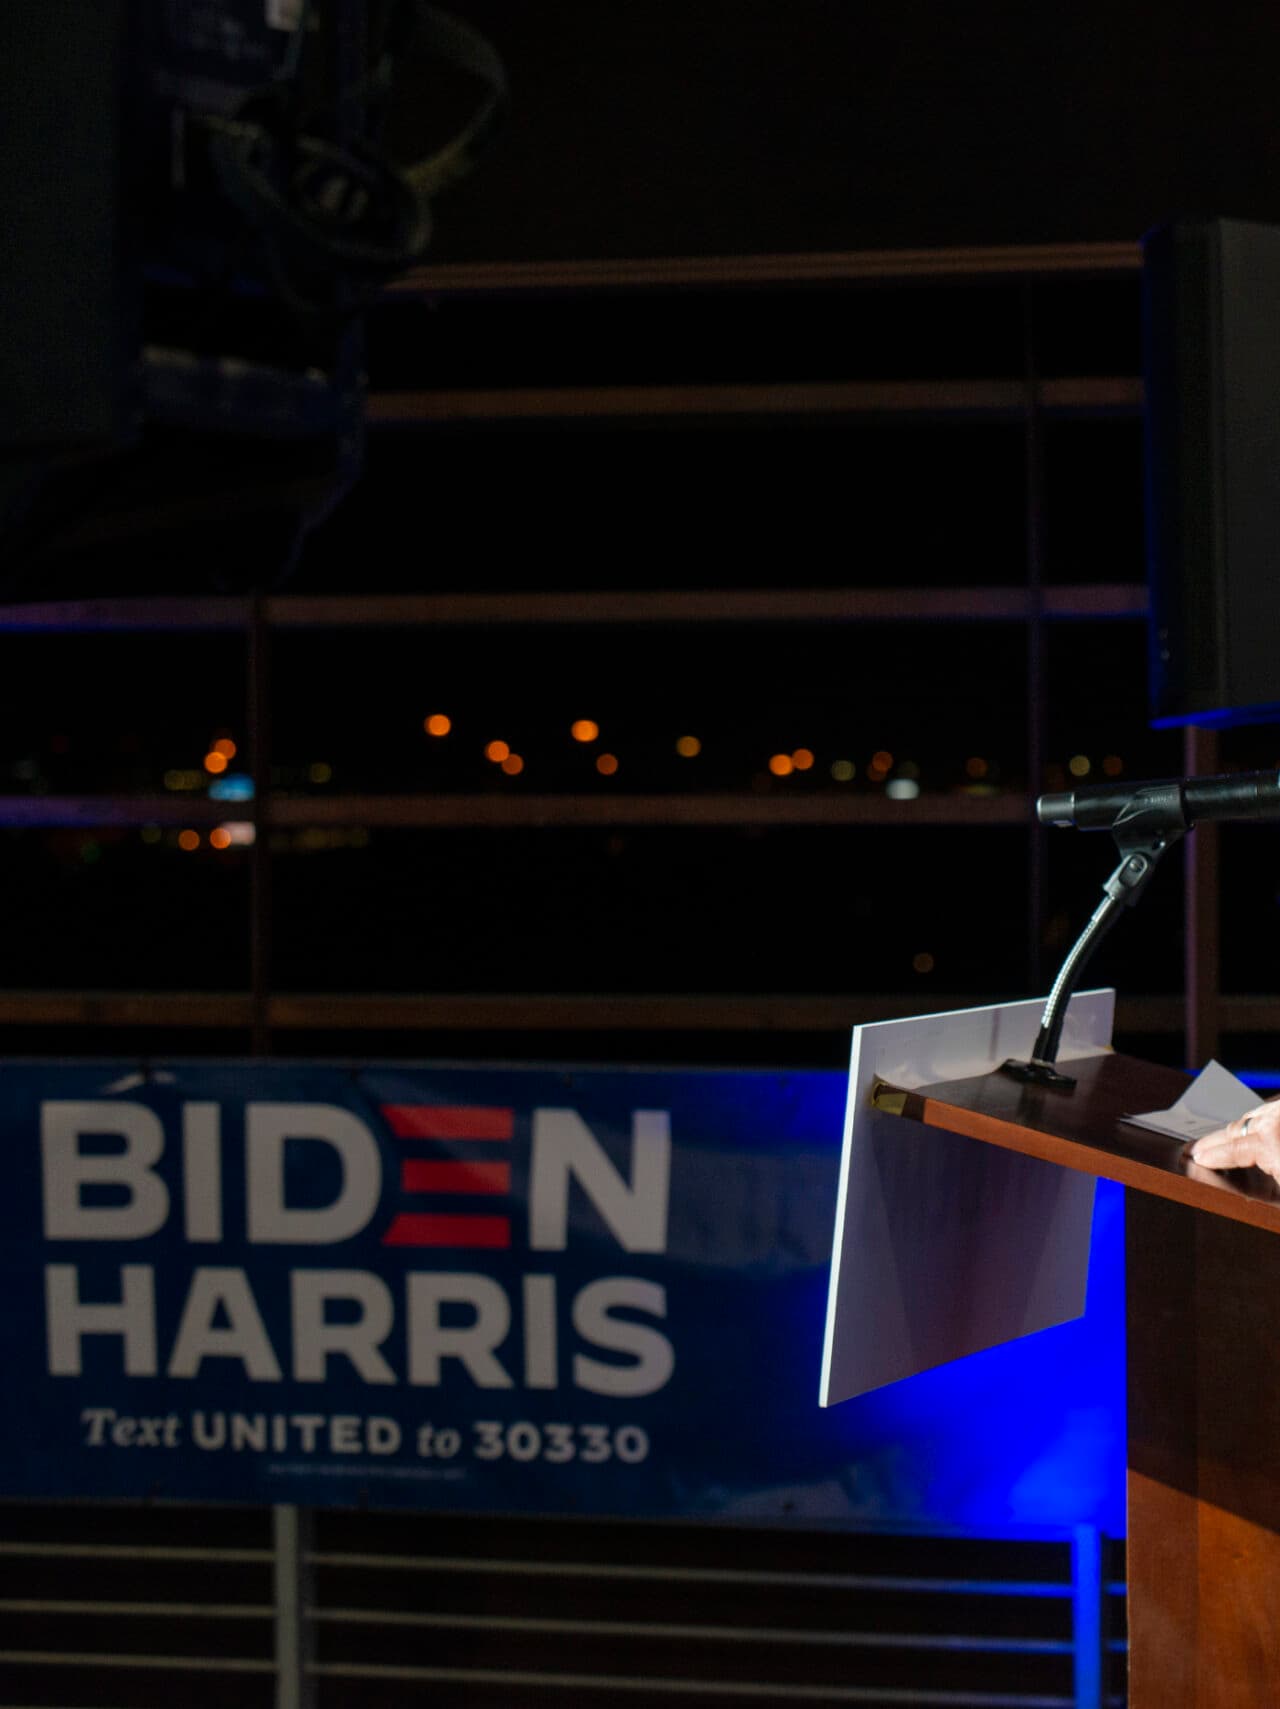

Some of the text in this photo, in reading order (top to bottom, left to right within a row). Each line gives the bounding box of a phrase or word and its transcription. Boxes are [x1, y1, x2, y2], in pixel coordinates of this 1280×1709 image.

[40, 1099, 672, 1254] BIDEN
[45, 1263, 677, 1398] HARRIS
[82, 1407, 650, 1463] Text UNITED to 30330
